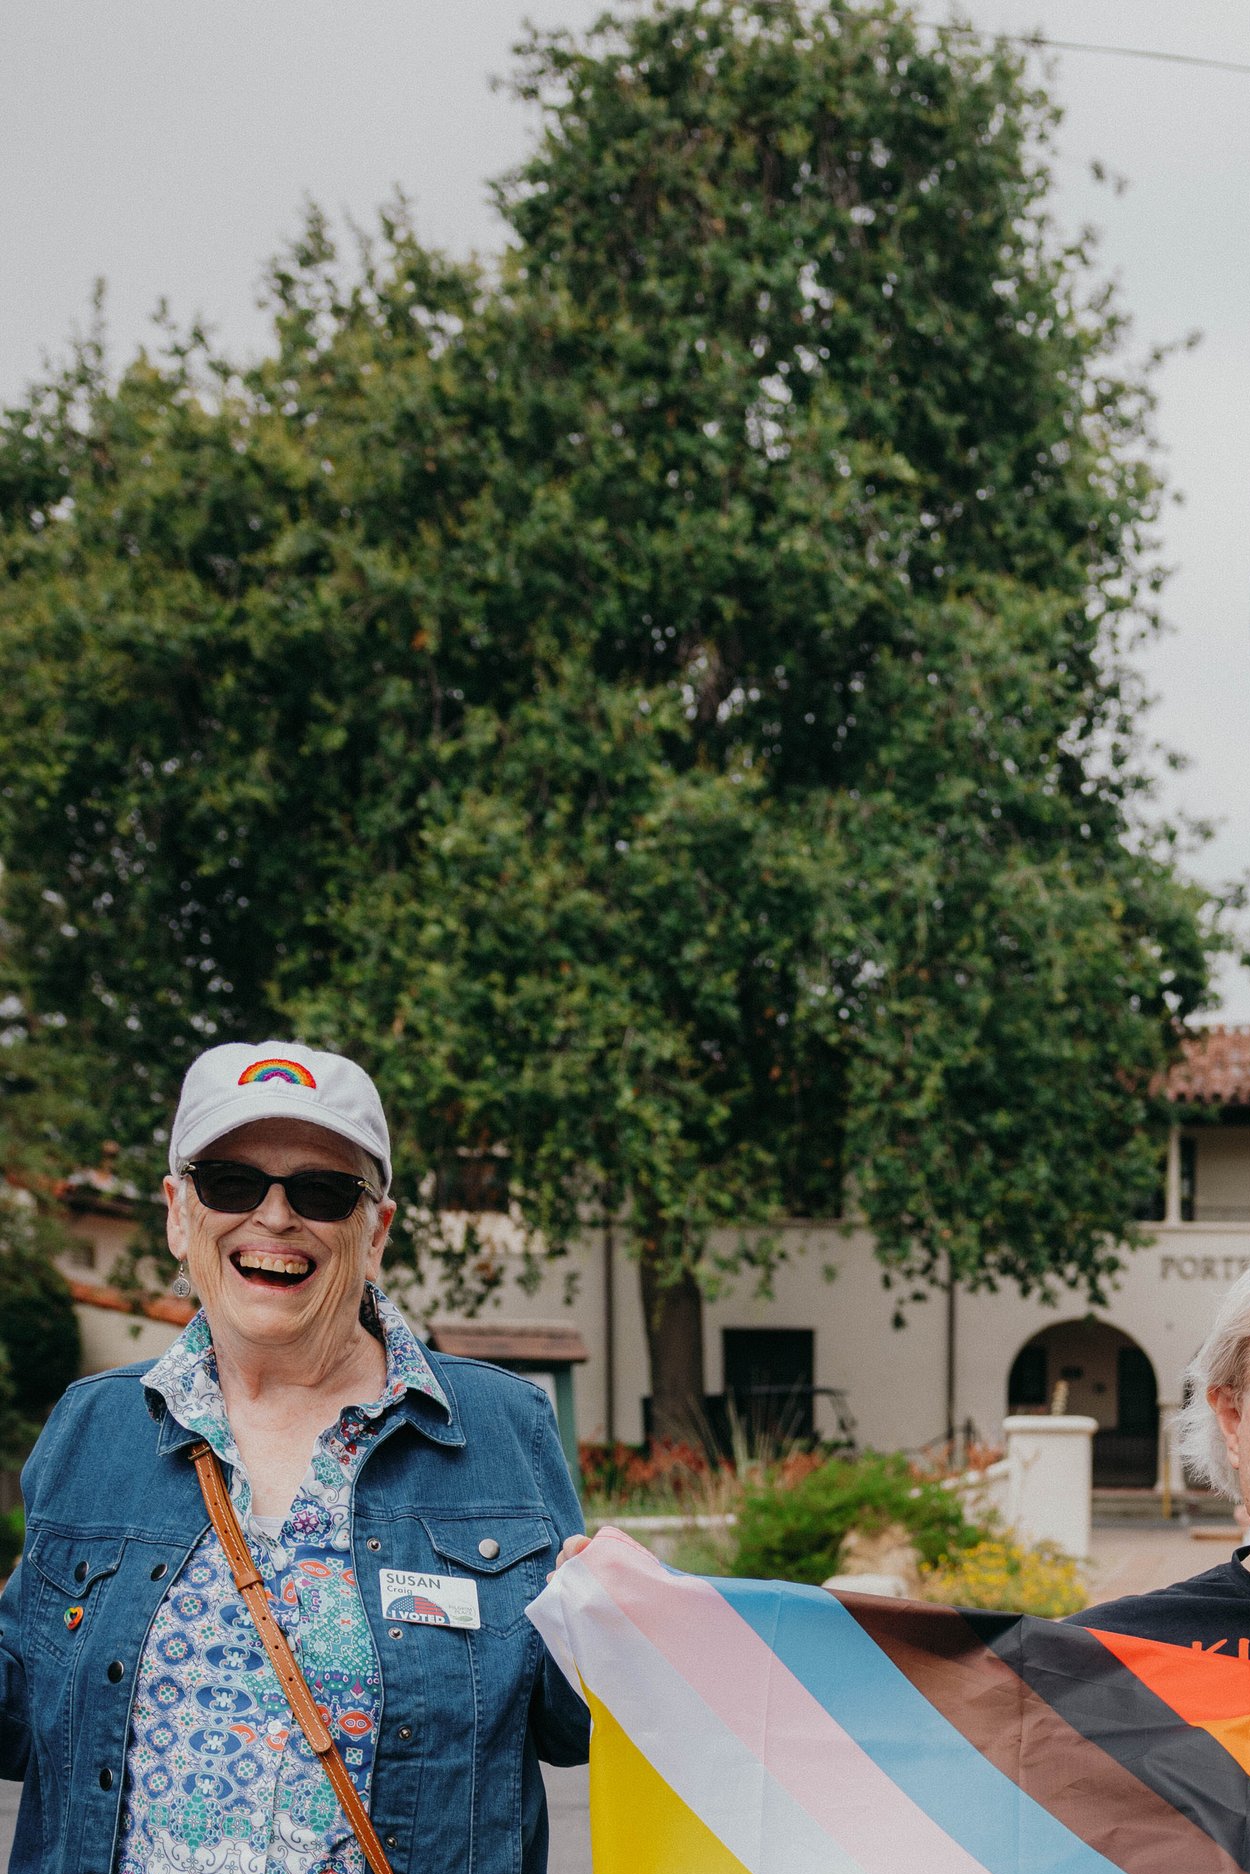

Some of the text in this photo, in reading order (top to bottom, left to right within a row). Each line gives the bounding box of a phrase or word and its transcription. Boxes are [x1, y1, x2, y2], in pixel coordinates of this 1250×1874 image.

[386, 1572, 441, 1590] SUSAN
[387, 1585, 413, 1596] Craig
[391, 1609, 397, 1619] I
[400, 1611, 446, 1624] VOTED
